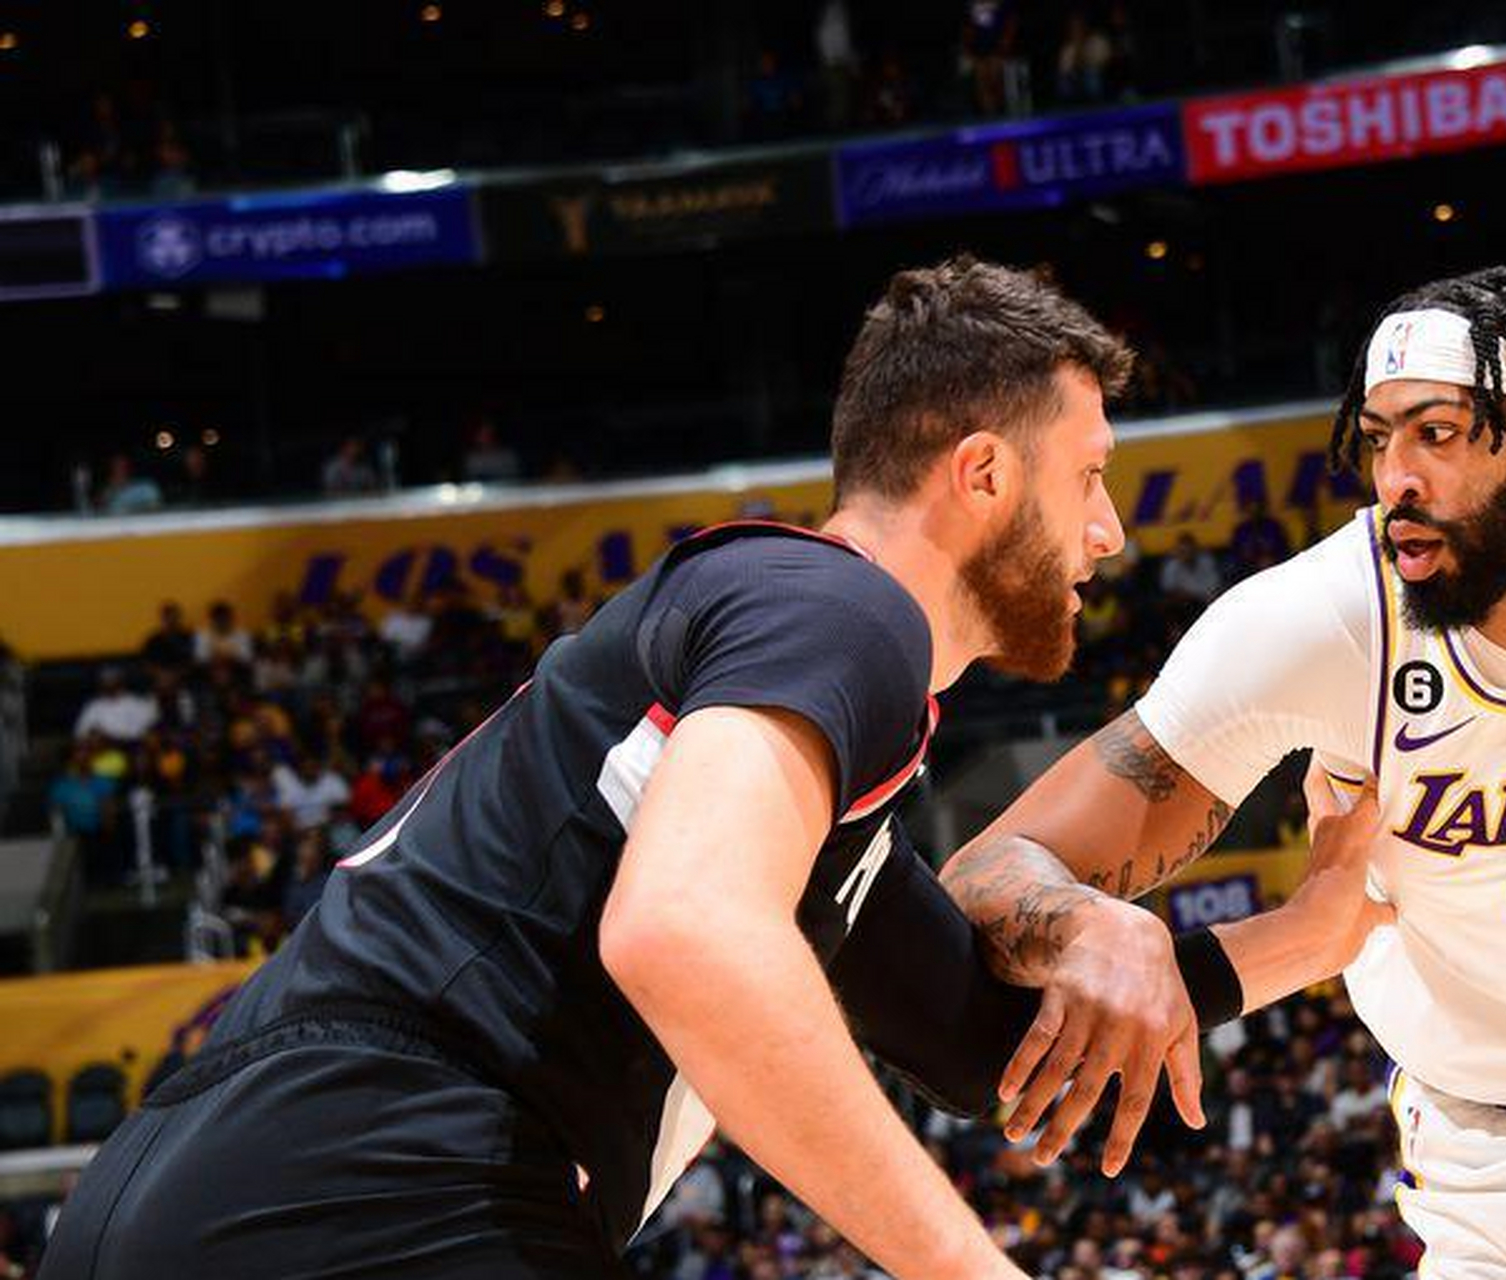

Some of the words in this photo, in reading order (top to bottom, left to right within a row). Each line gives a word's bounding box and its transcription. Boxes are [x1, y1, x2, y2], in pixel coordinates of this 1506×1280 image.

[1020, 126, 1172, 184] ULTRA
[207, 212, 437, 258] crypto.com
[1404, 669, 1433, 709] 6
